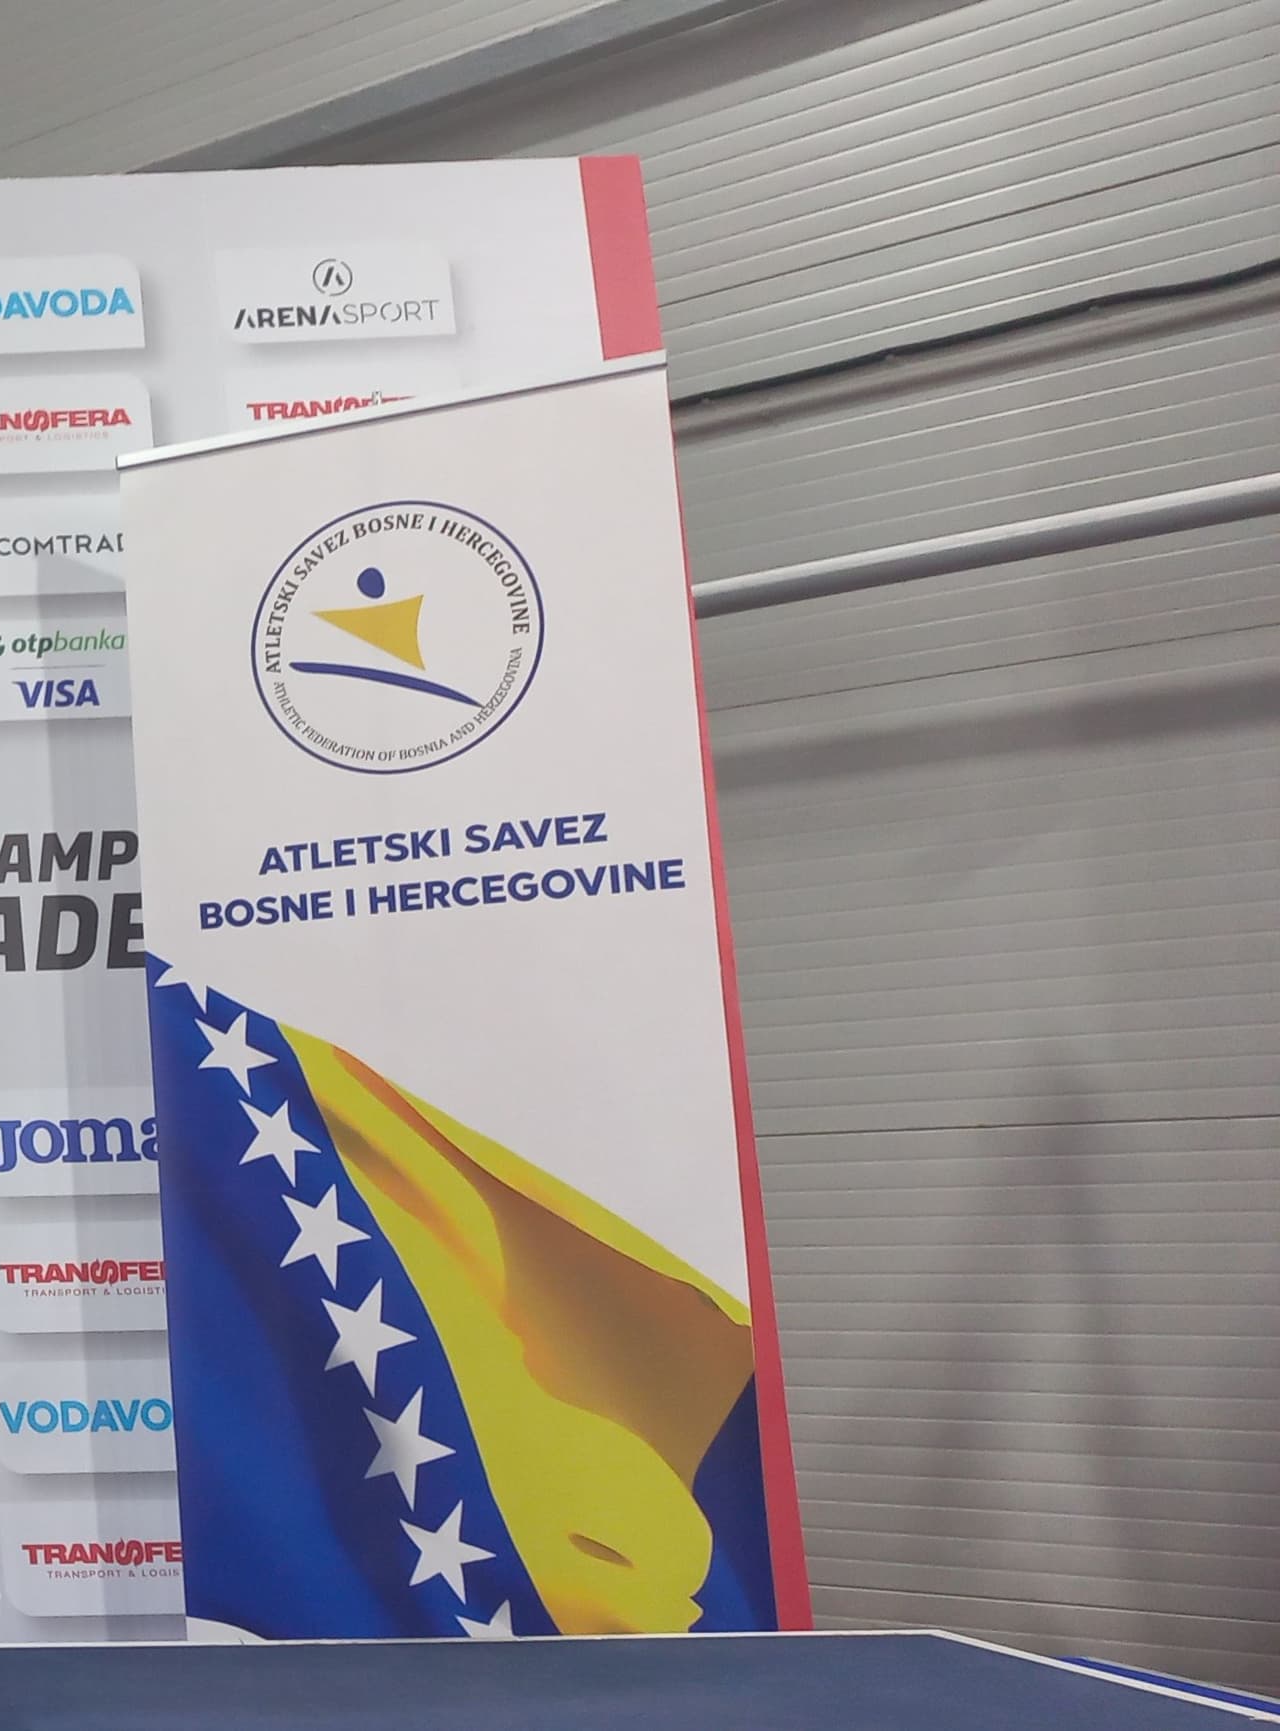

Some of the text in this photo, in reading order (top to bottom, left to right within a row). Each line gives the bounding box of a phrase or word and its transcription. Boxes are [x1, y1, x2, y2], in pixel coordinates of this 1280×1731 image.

[234, 299, 439, 330] ARENASPORT
[266, 513, 531, 674] ATLETSKI SAVEZ BOSNE I HERCEGOVINE
[11, 628, 126, 660] otpbanka
[12, 679, 100, 708] VISA
[302, 725, 376, 761] FEDERATION
[259, 813, 608, 875] ATLETSKI SAVEZ
[199, 858, 686, 930] BOSNE I HERCEGOVINE
[23, 1287, 97, 1298] TRANSPORT
[47, 1570, 122, 1580] TRANSPORT
